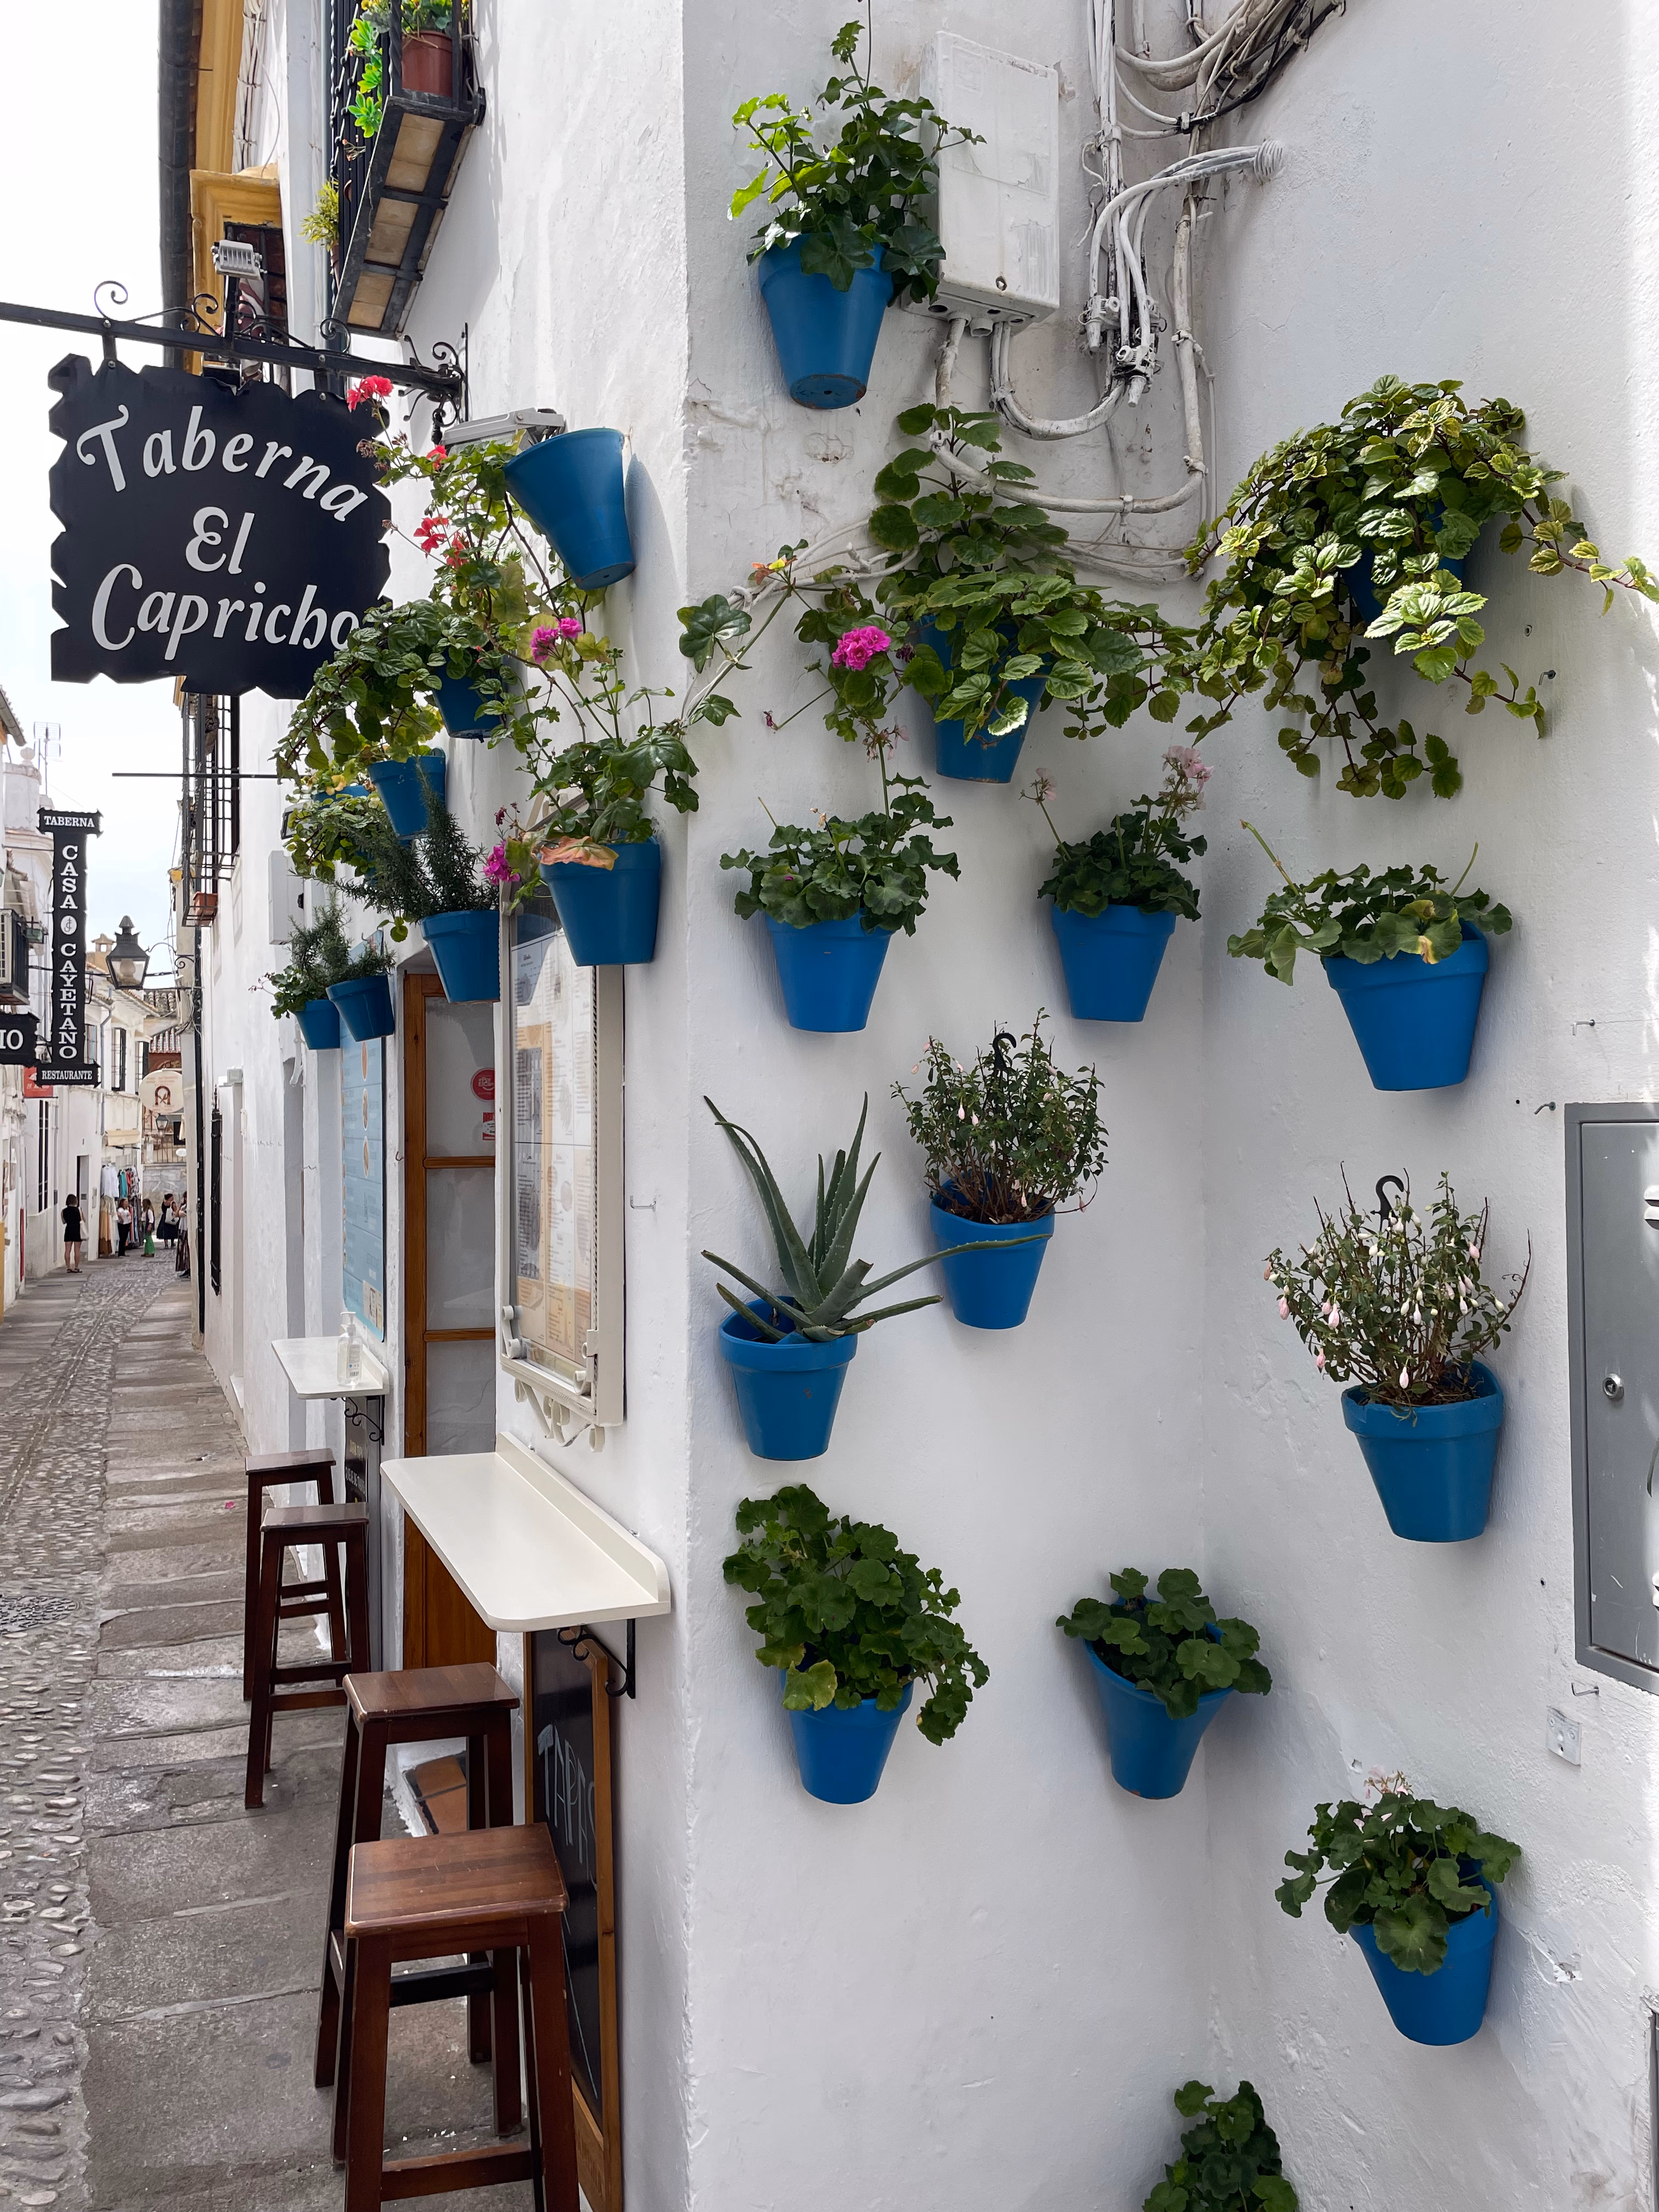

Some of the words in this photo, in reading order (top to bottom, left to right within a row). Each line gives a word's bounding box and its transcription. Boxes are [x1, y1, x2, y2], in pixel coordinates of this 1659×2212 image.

[76, 404, 368, 522] Taberna
[185, 506, 255, 575] El
[92, 563, 360, 661] Capricho
[43, 815, 95, 828] TABERNA
[60, 845, 79, 910] CASA
[58, 943, 78, 1059] CAYETANO
[42, 1070, 93, 1080] RESTAURANTE
